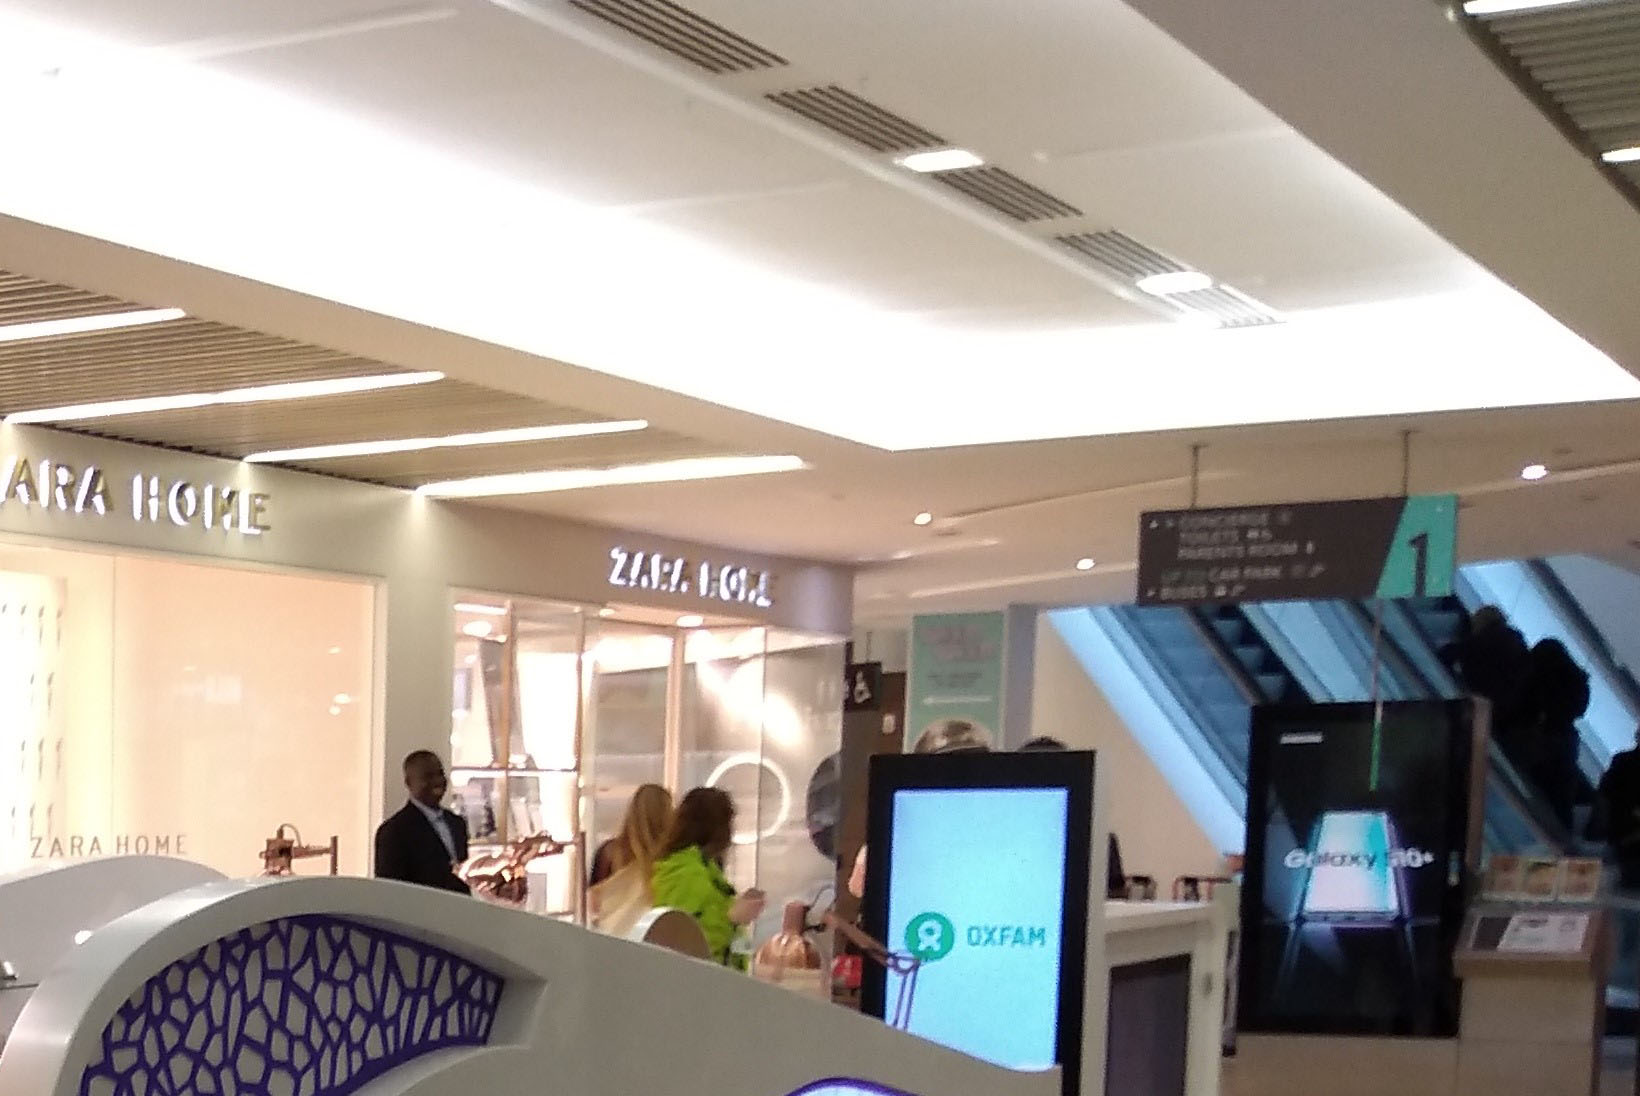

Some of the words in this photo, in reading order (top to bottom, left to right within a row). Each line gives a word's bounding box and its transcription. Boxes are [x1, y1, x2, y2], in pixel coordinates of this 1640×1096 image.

[132, 474, 271, 536] HOME
[1409, 532, 1429, 602] 1
[31, 836, 102, 858] ZARA
[116, 835, 187, 855] HOME
[1284, 847, 1377, 870] Galaxy
[967, 926, 1046, 948] OXFAM
